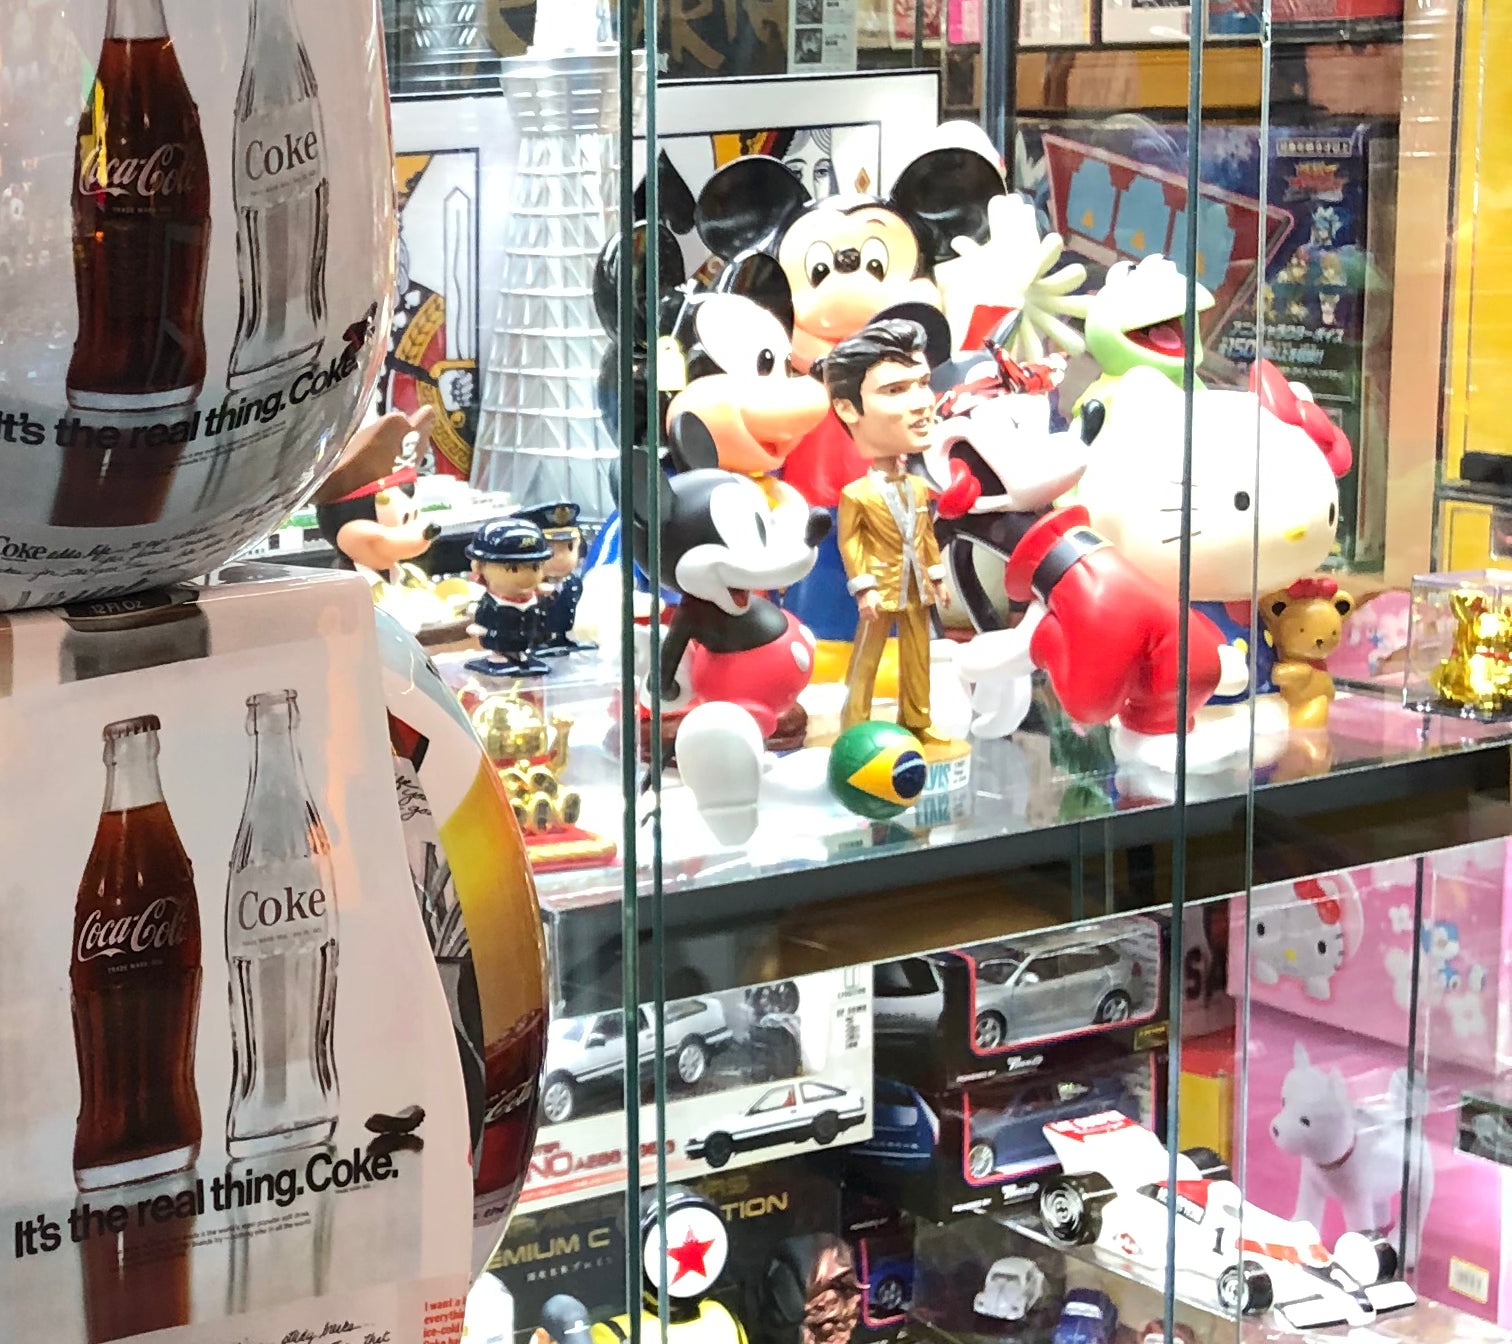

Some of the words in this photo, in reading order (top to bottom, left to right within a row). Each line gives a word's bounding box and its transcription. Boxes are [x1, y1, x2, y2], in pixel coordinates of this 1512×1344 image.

[244, 127, 319, 182] Coke
[54, 417, 121, 450] the
[130, 409, 202, 450] real
[204, 390, 287, 438] thing.
[238, 884, 326, 932] Coke
[14, 1213, 62, 1259] It's
[68, 1200, 128, 1244] the
[137, 1180, 204, 1231] real
[210, 1164, 304, 1213] thing.
[306, 1146, 399, 1195] Coke.
